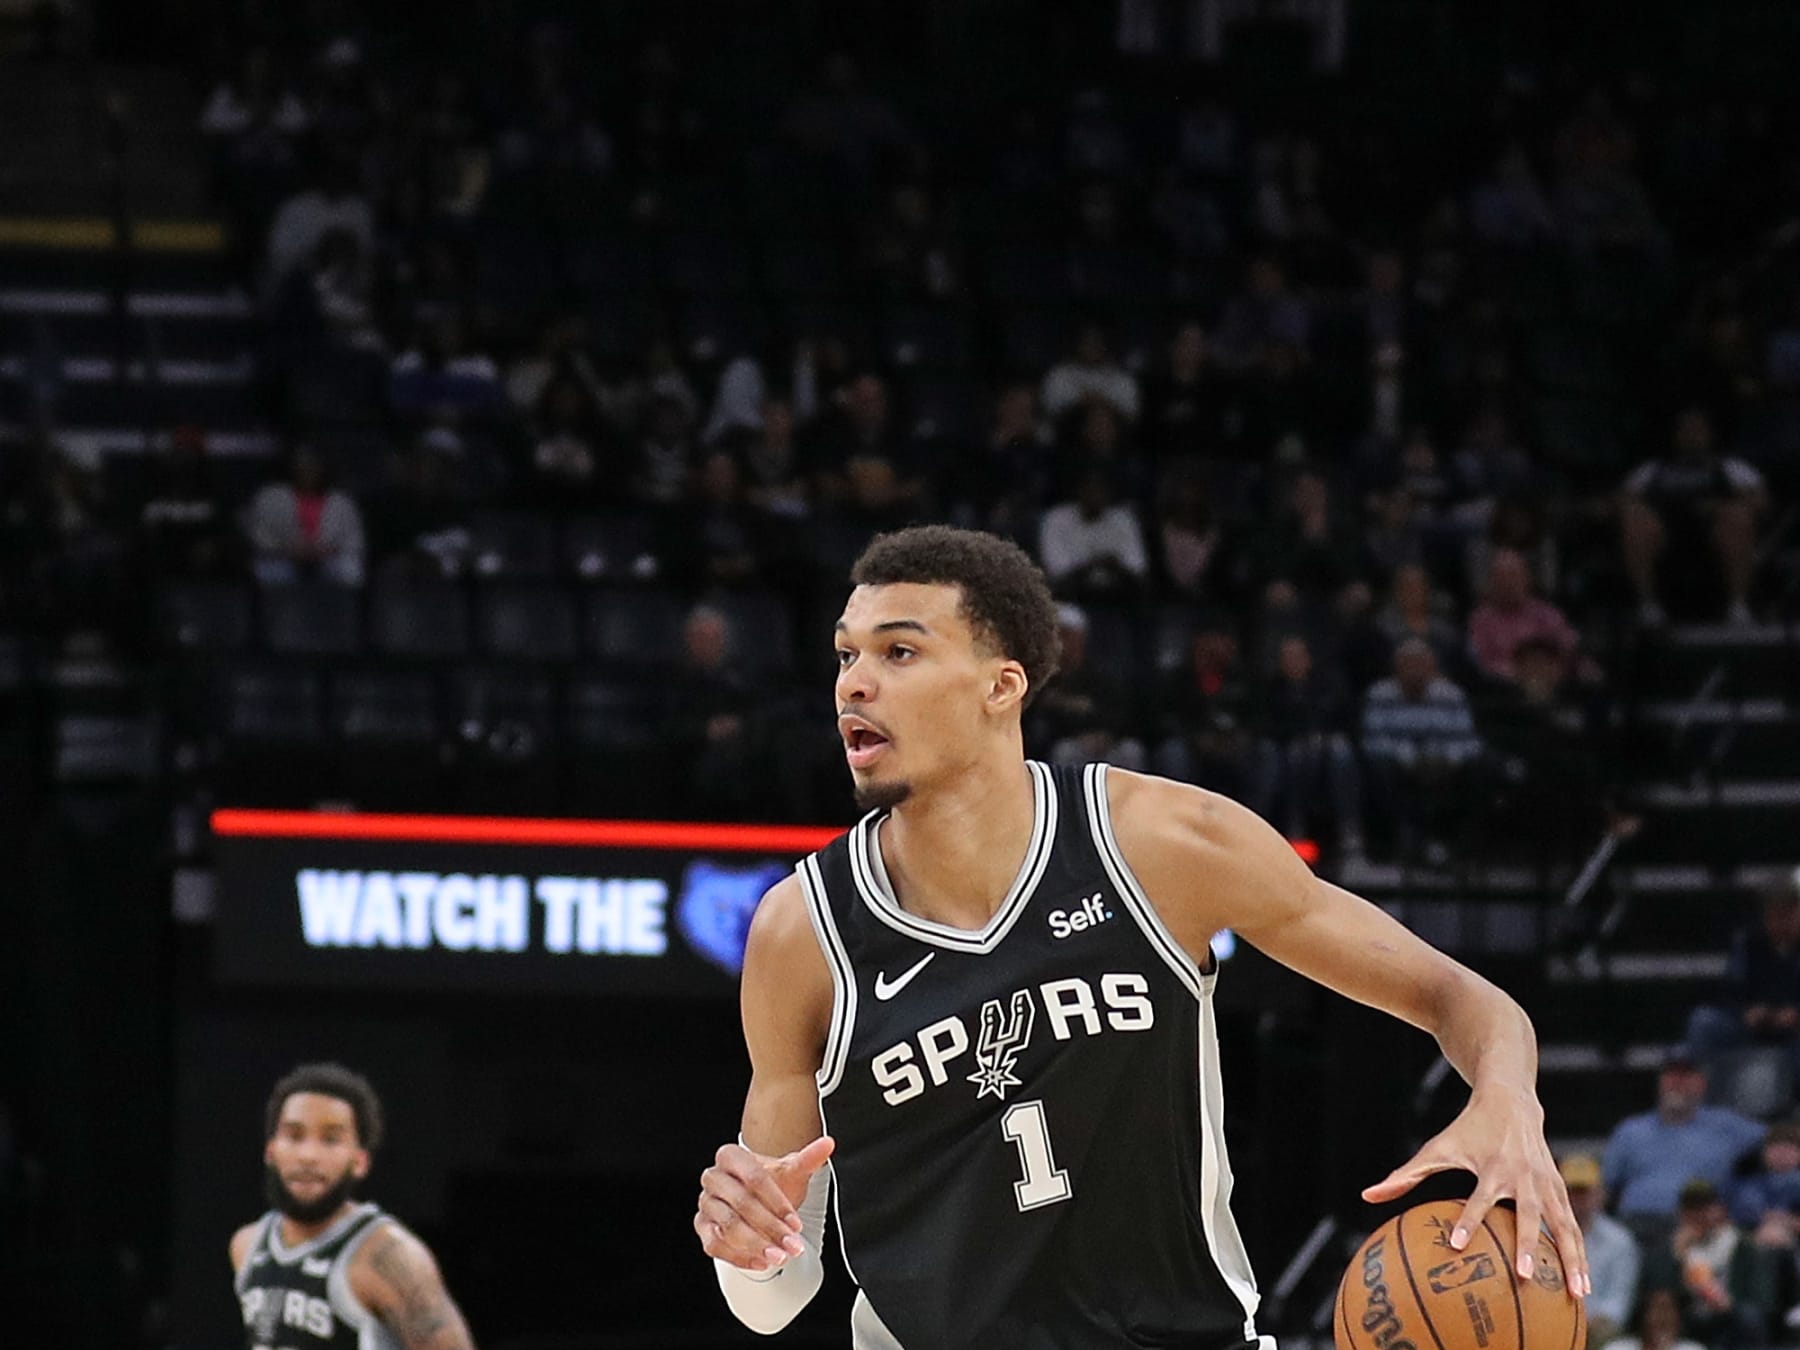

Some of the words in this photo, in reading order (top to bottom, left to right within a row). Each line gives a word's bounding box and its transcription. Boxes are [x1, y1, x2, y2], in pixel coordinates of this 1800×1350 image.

[298, 868, 530, 953] WATCH
[536, 874, 669, 957] THE
[871, 973, 1155, 1106] SPURS
[1001, 1099, 1073, 1213] 1
[240, 1287, 333, 1340] PRS
